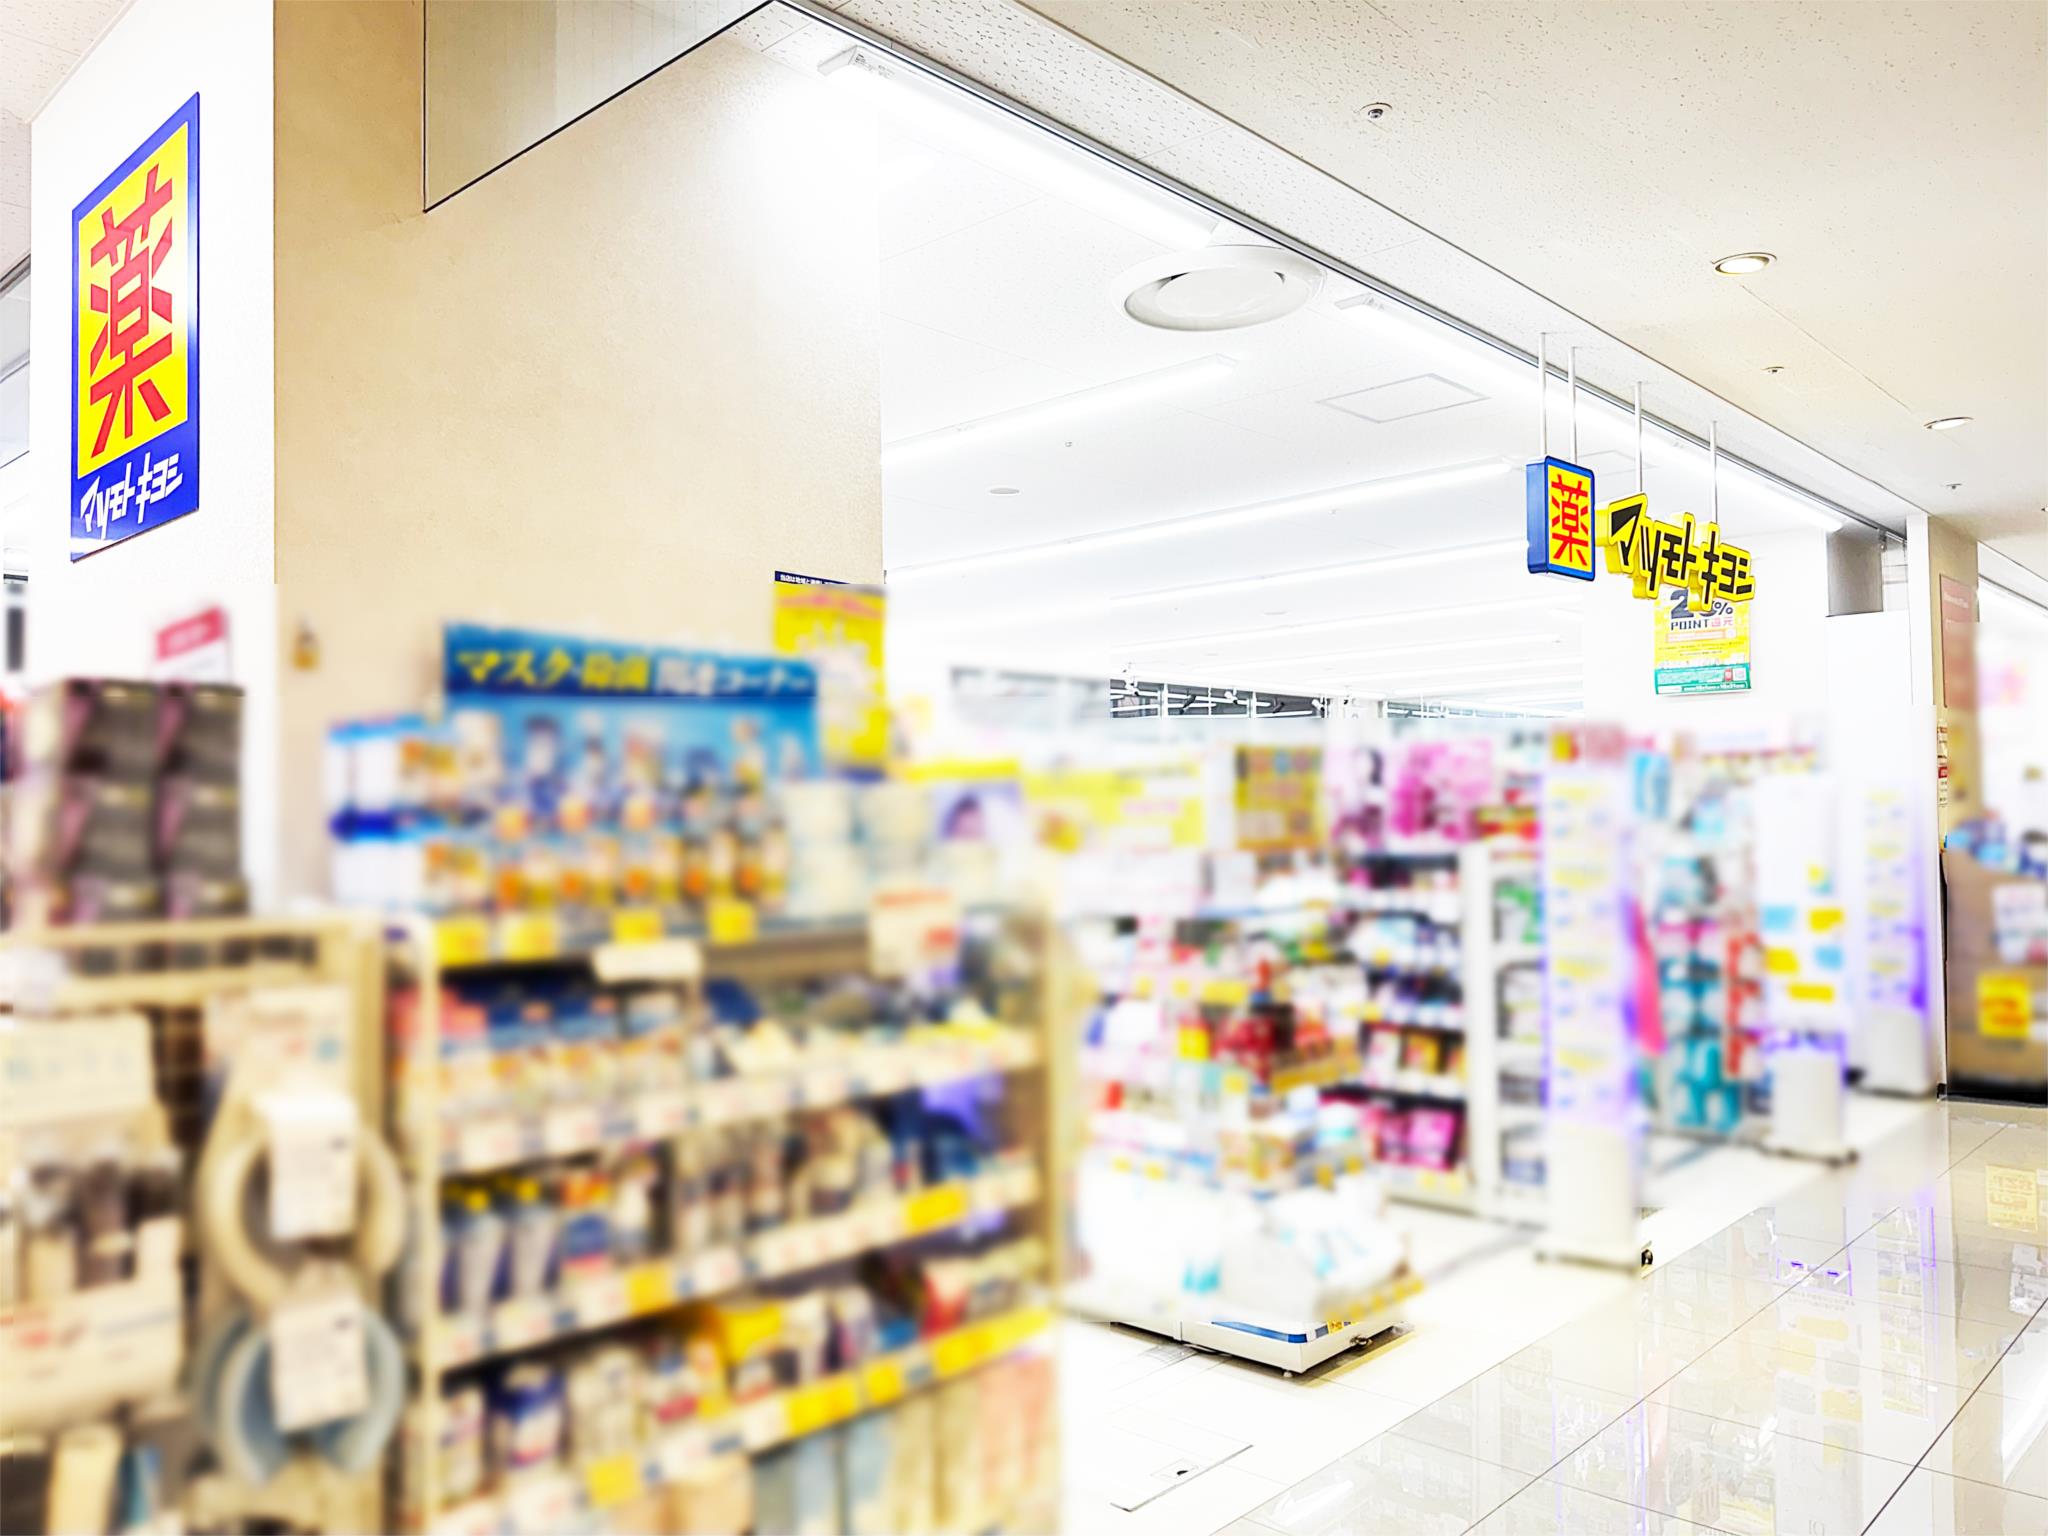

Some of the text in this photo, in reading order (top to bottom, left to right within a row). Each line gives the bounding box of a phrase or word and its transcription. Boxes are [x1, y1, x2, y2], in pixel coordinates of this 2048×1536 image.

[90, 163, 173, 459] 薬
[80, 450, 184, 541] マツモトキヨシ
[1551, 474, 1589, 567] 薬
[1611, 502, 1754, 606] マツモトキヨシ
